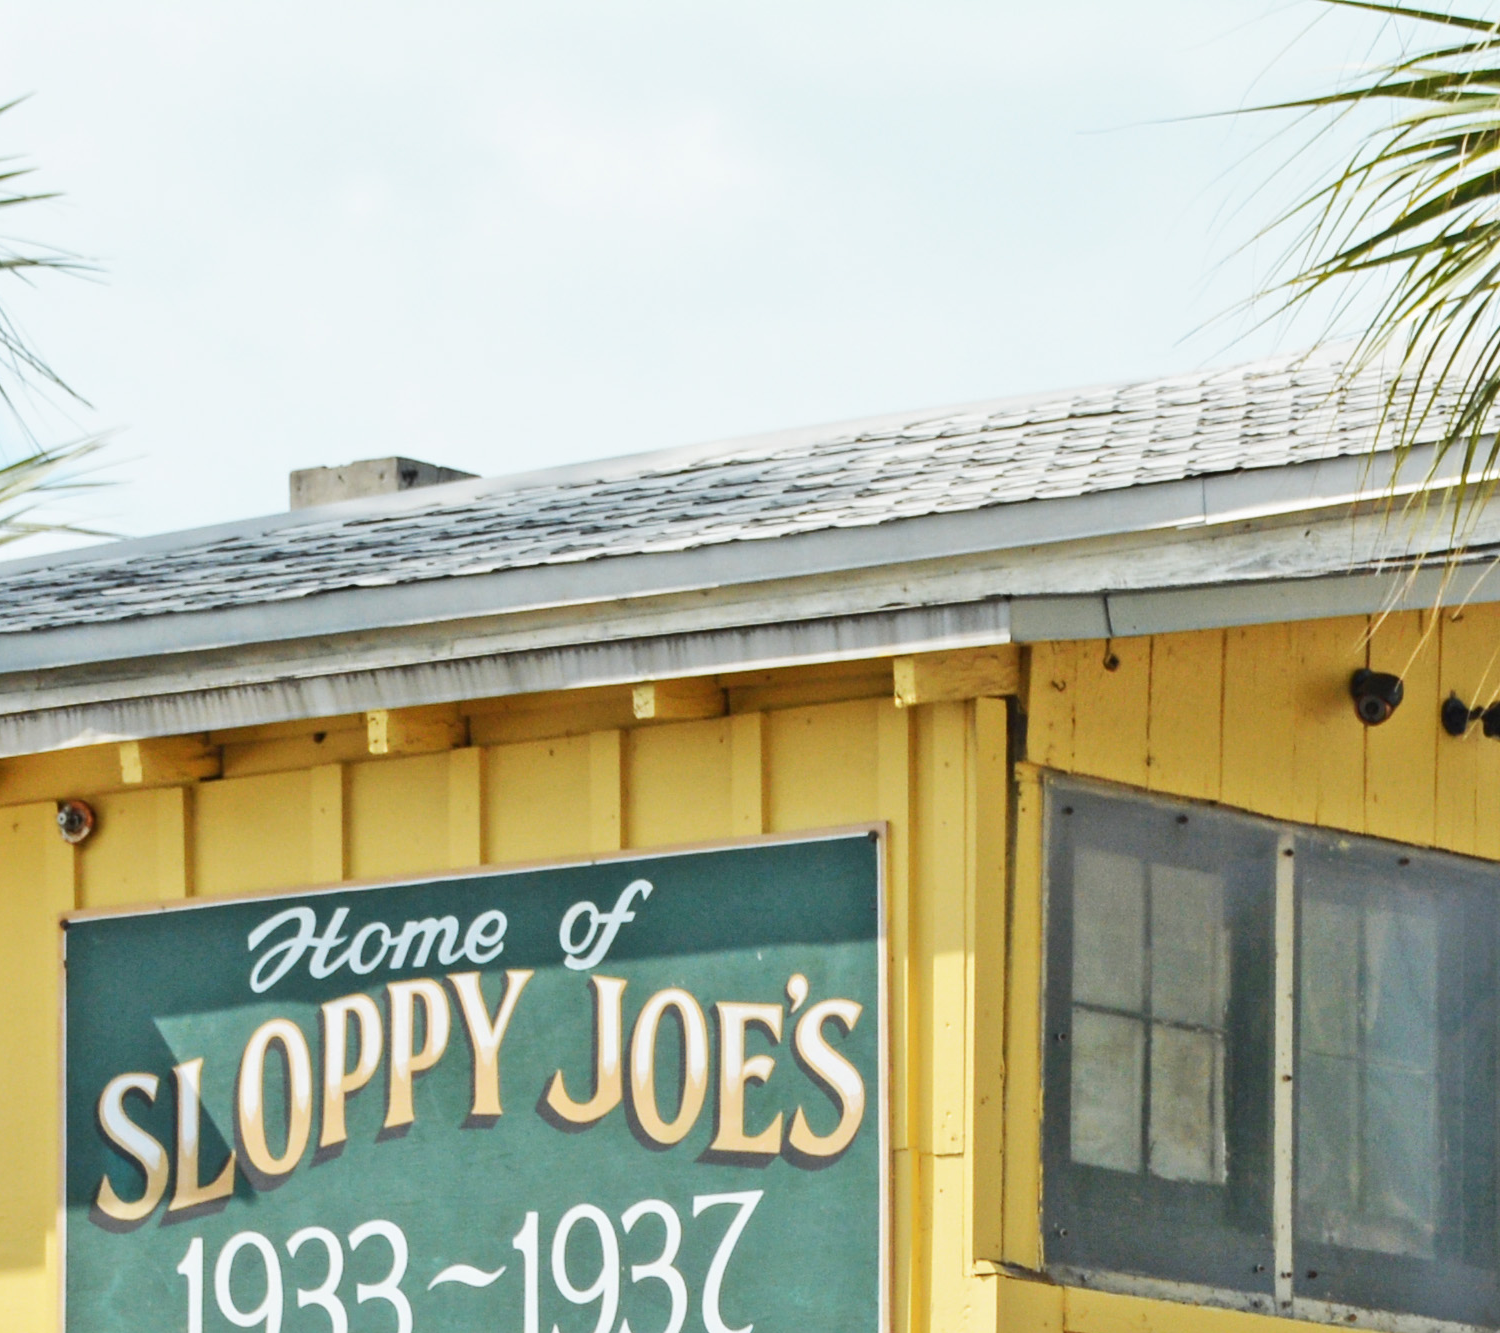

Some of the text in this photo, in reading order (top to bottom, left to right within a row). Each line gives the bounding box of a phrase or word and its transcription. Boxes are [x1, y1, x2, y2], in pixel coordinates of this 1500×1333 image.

[247, 878, 654, 994] Home of
[94, 968, 868, 1226] SLOPPY JOE'S
